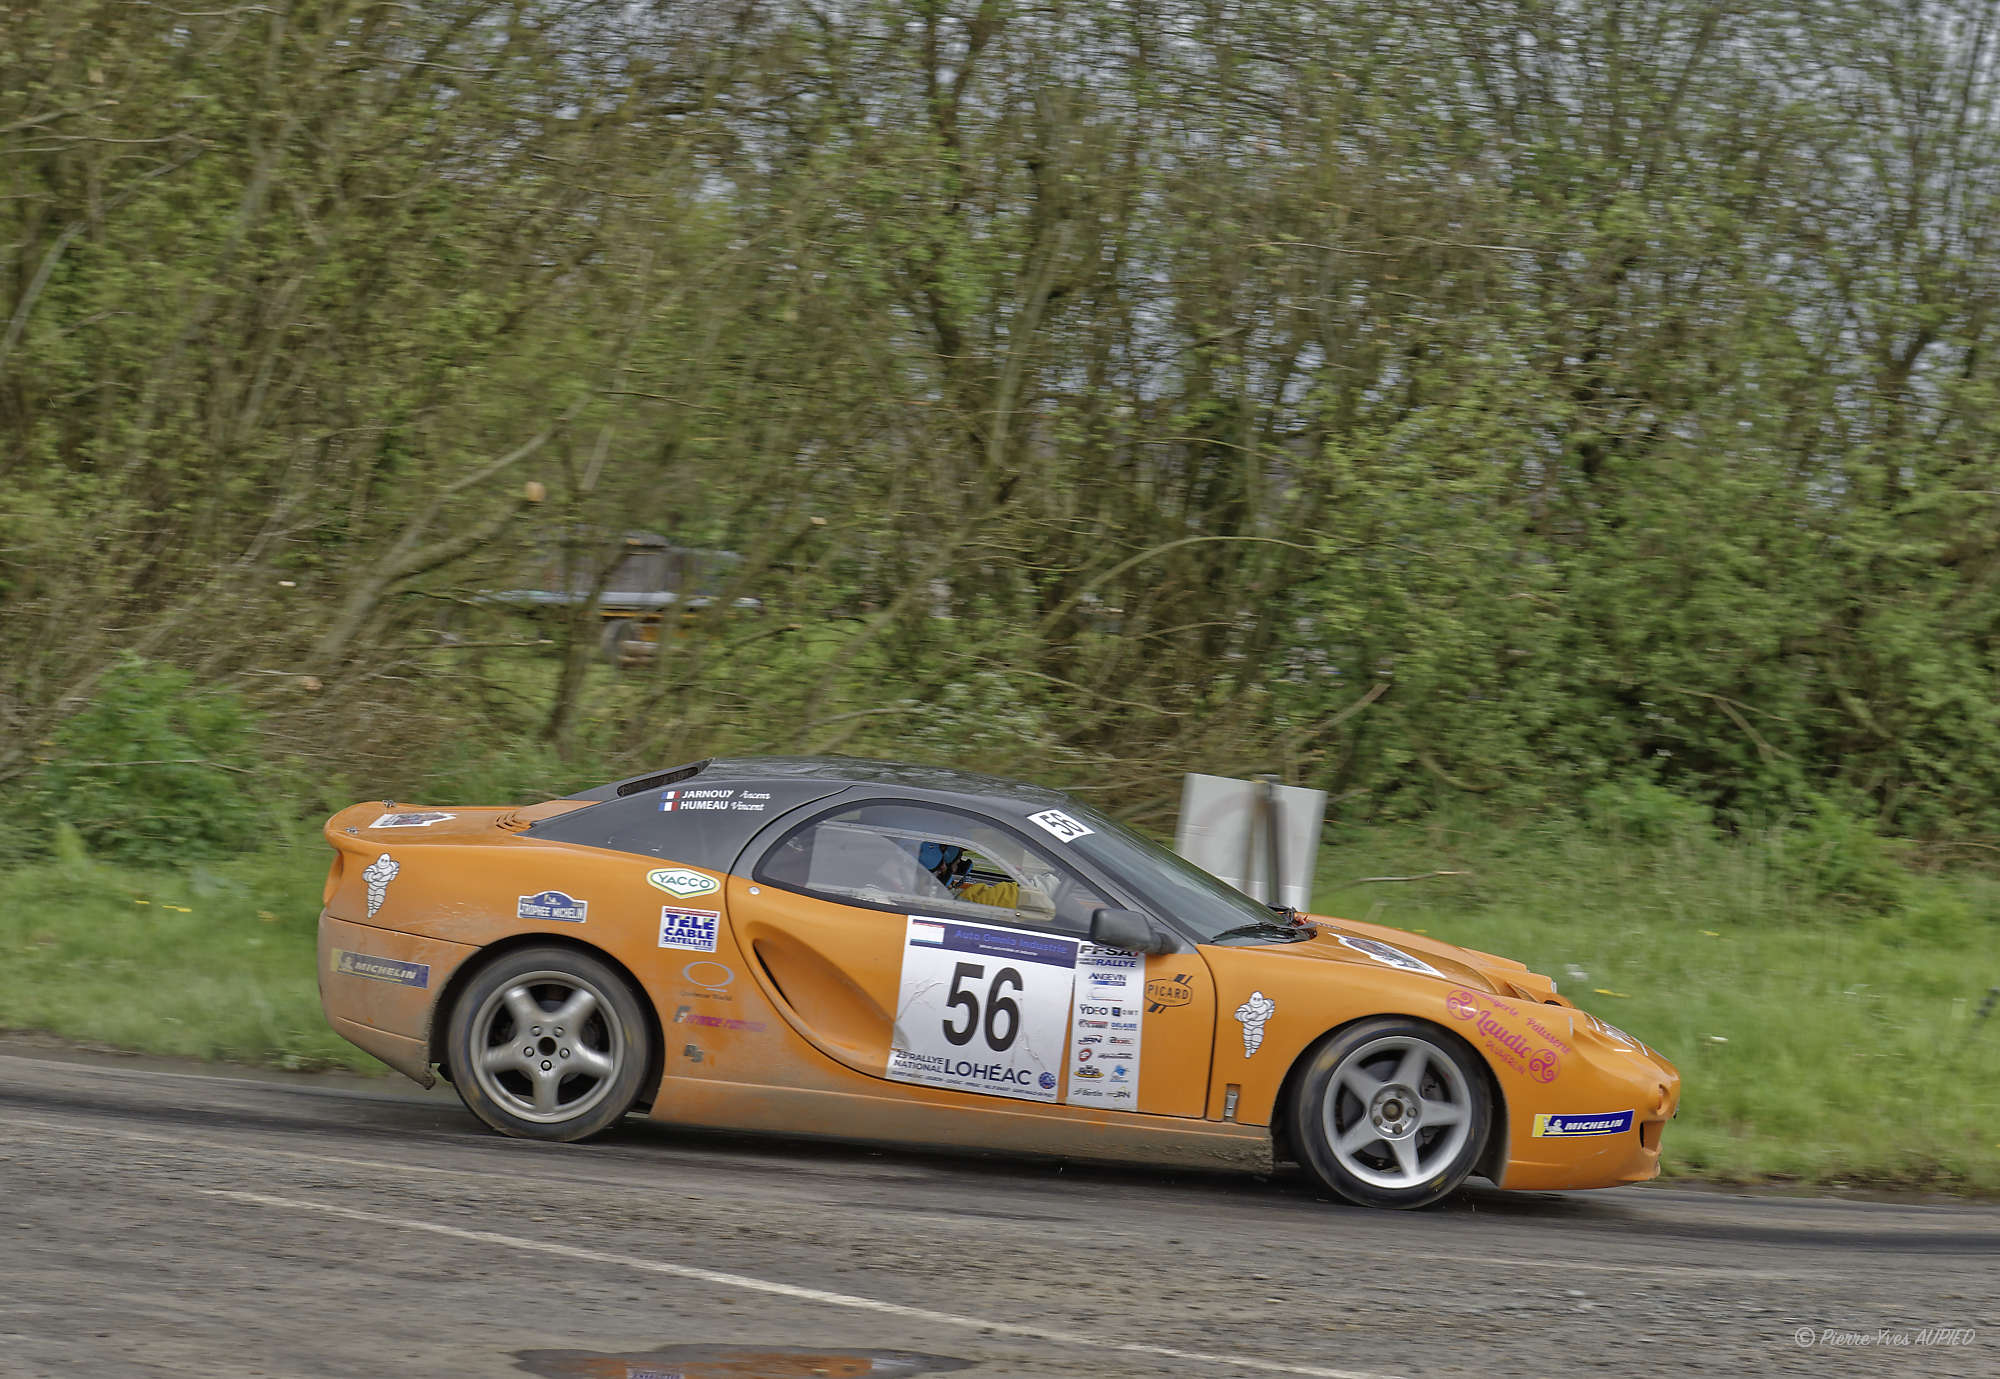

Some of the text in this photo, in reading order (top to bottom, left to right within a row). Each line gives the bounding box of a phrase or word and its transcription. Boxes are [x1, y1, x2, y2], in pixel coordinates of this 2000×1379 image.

[682, 789, 734, 799] JARNOUY
[680, 801, 729, 810] HUMEAU
[1039, 812, 1085, 836] 56
[658, 873, 711, 889] YACCO
[663, 936, 713, 947] SATELLITE
[955, 929, 979, 941] Auto
[355, 961, 417, 979] MICHELIN
[1096, 958, 1136, 968] RALLYE
[1148, 984, 1189, 999] PICARD
[943, 961, 1024, 1052] 56
[909, 1052, 944, 1065] RALLYE
[894, 1059, 943, 1074] NATIONAL
[944, 1057, 1032, 1086] LOHÉAC
[1564, 1119, 1625, 1131] MICHELIN
